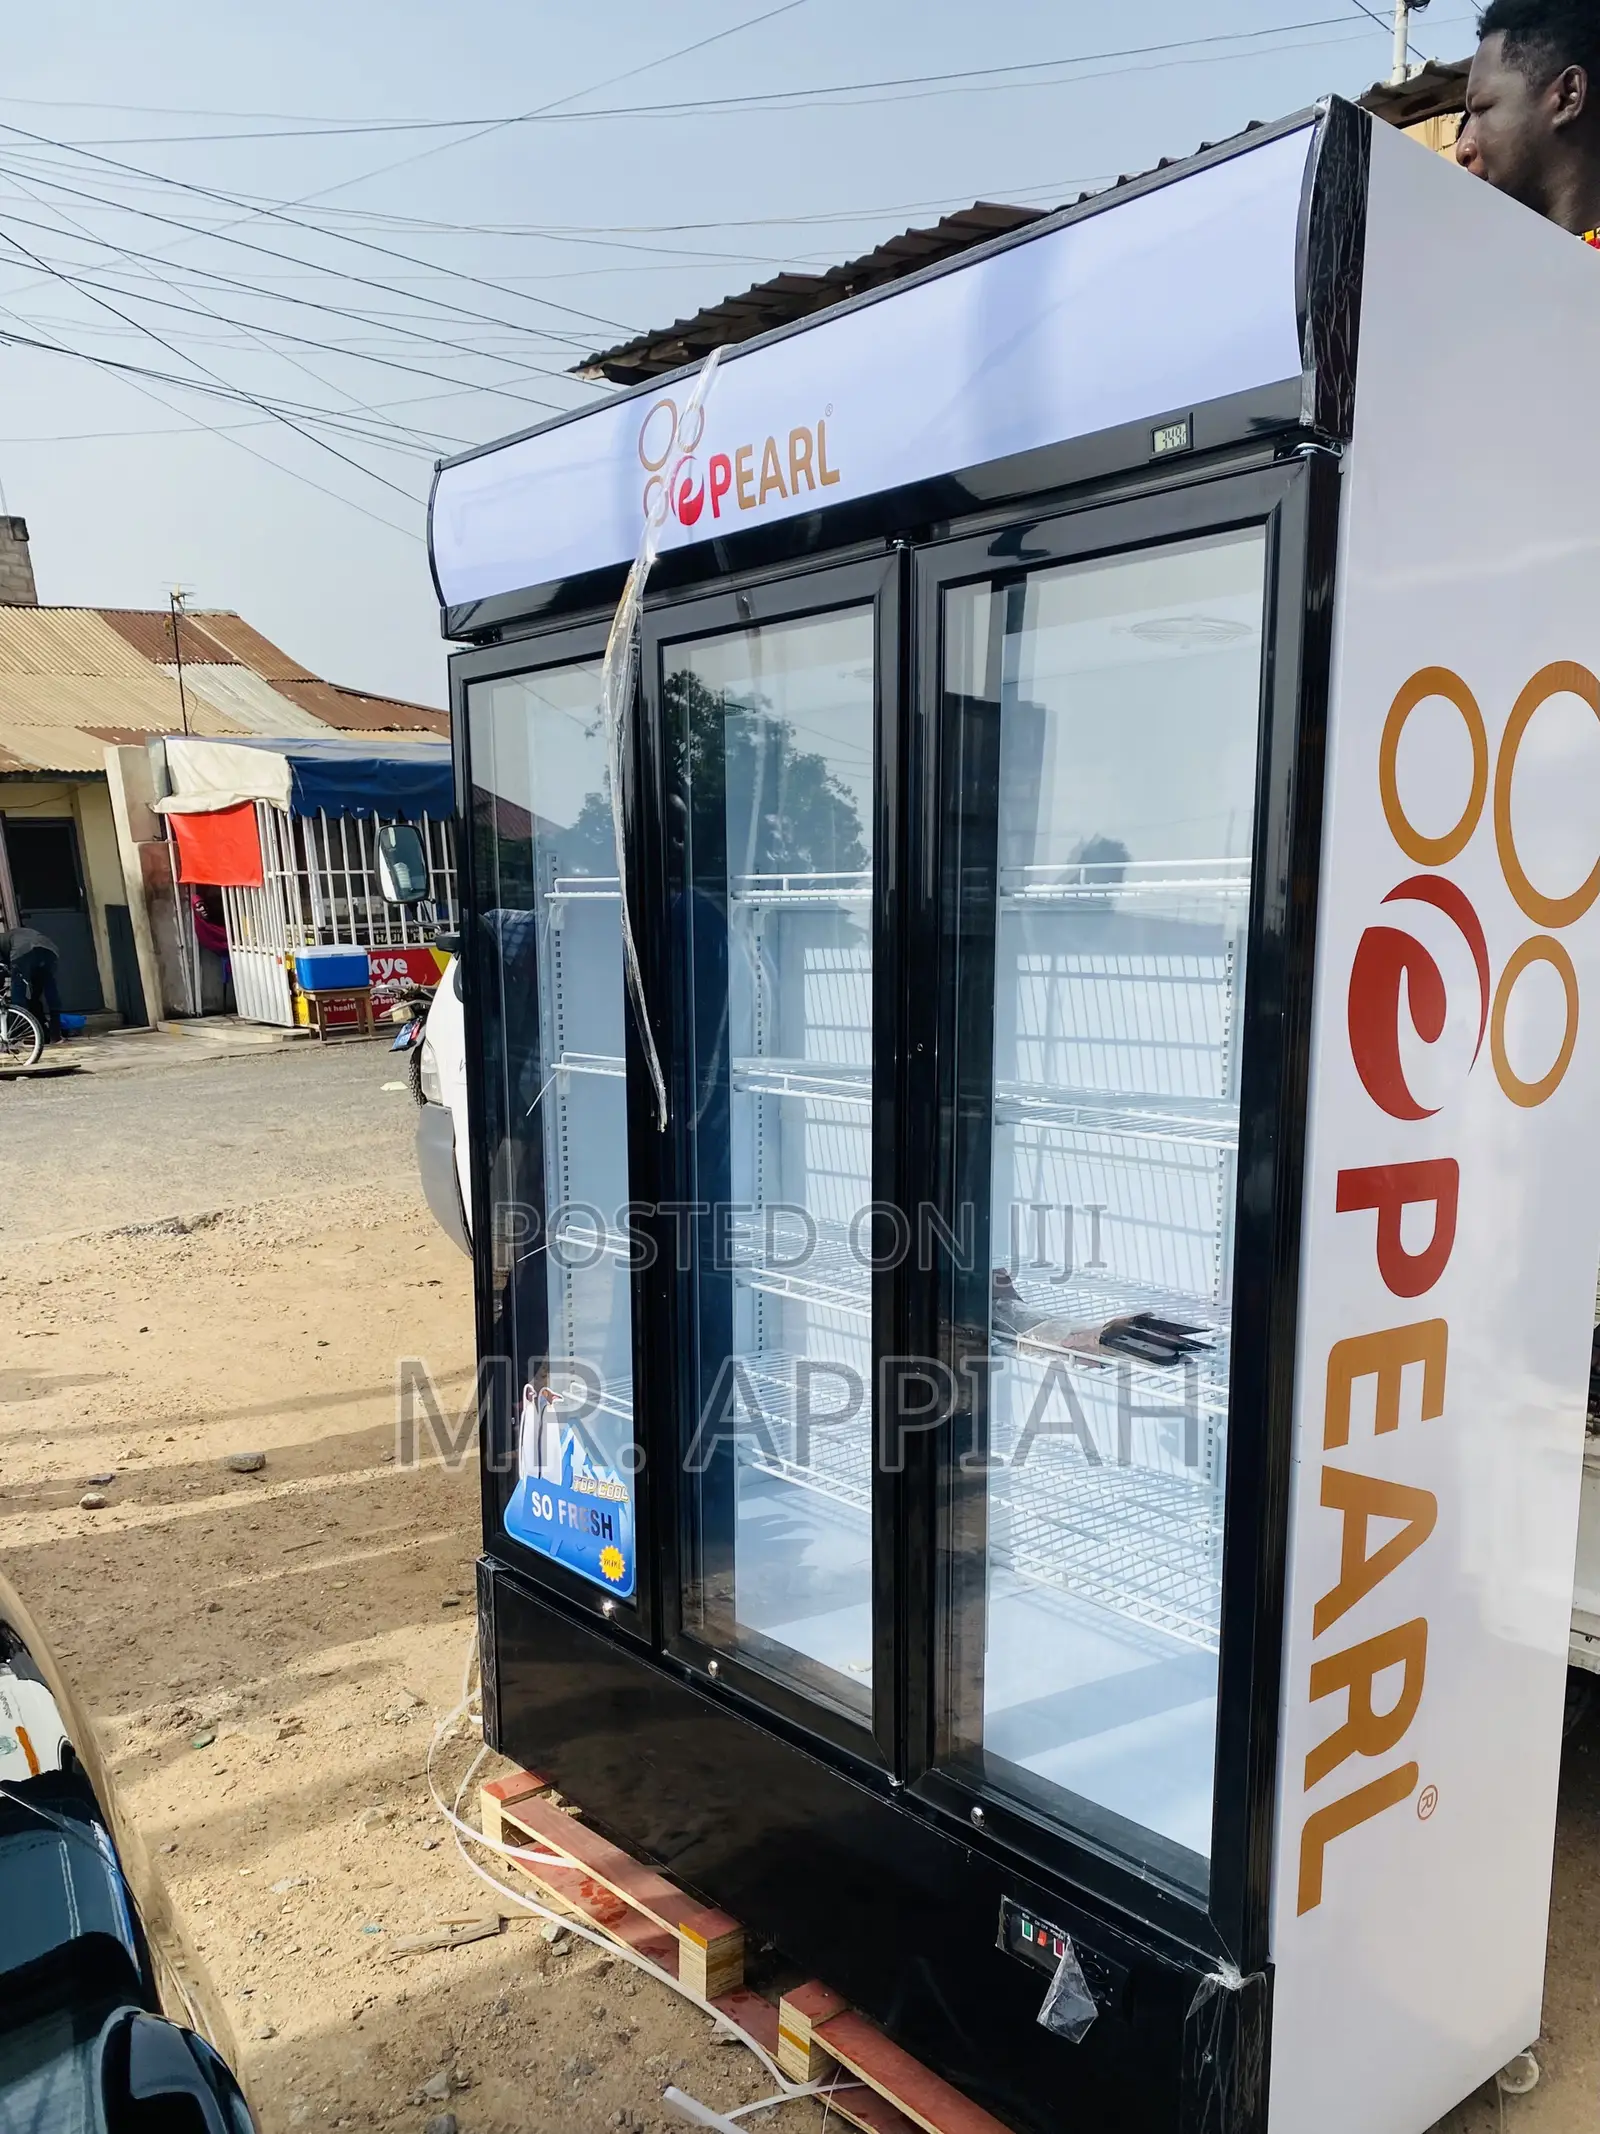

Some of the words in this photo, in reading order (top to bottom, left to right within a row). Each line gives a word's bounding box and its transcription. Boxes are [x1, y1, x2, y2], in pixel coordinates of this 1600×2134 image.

[709, 419, 840, 519] PEARL
[531, 1490, 553, 1521] SO
[557, 1499, 613, 1541] FRESH
[572, 1475, 596, 1497] TOP
[598, 1478, 630, 1502] COOL
[1296, 1157, 1460, 1917] PEARL
